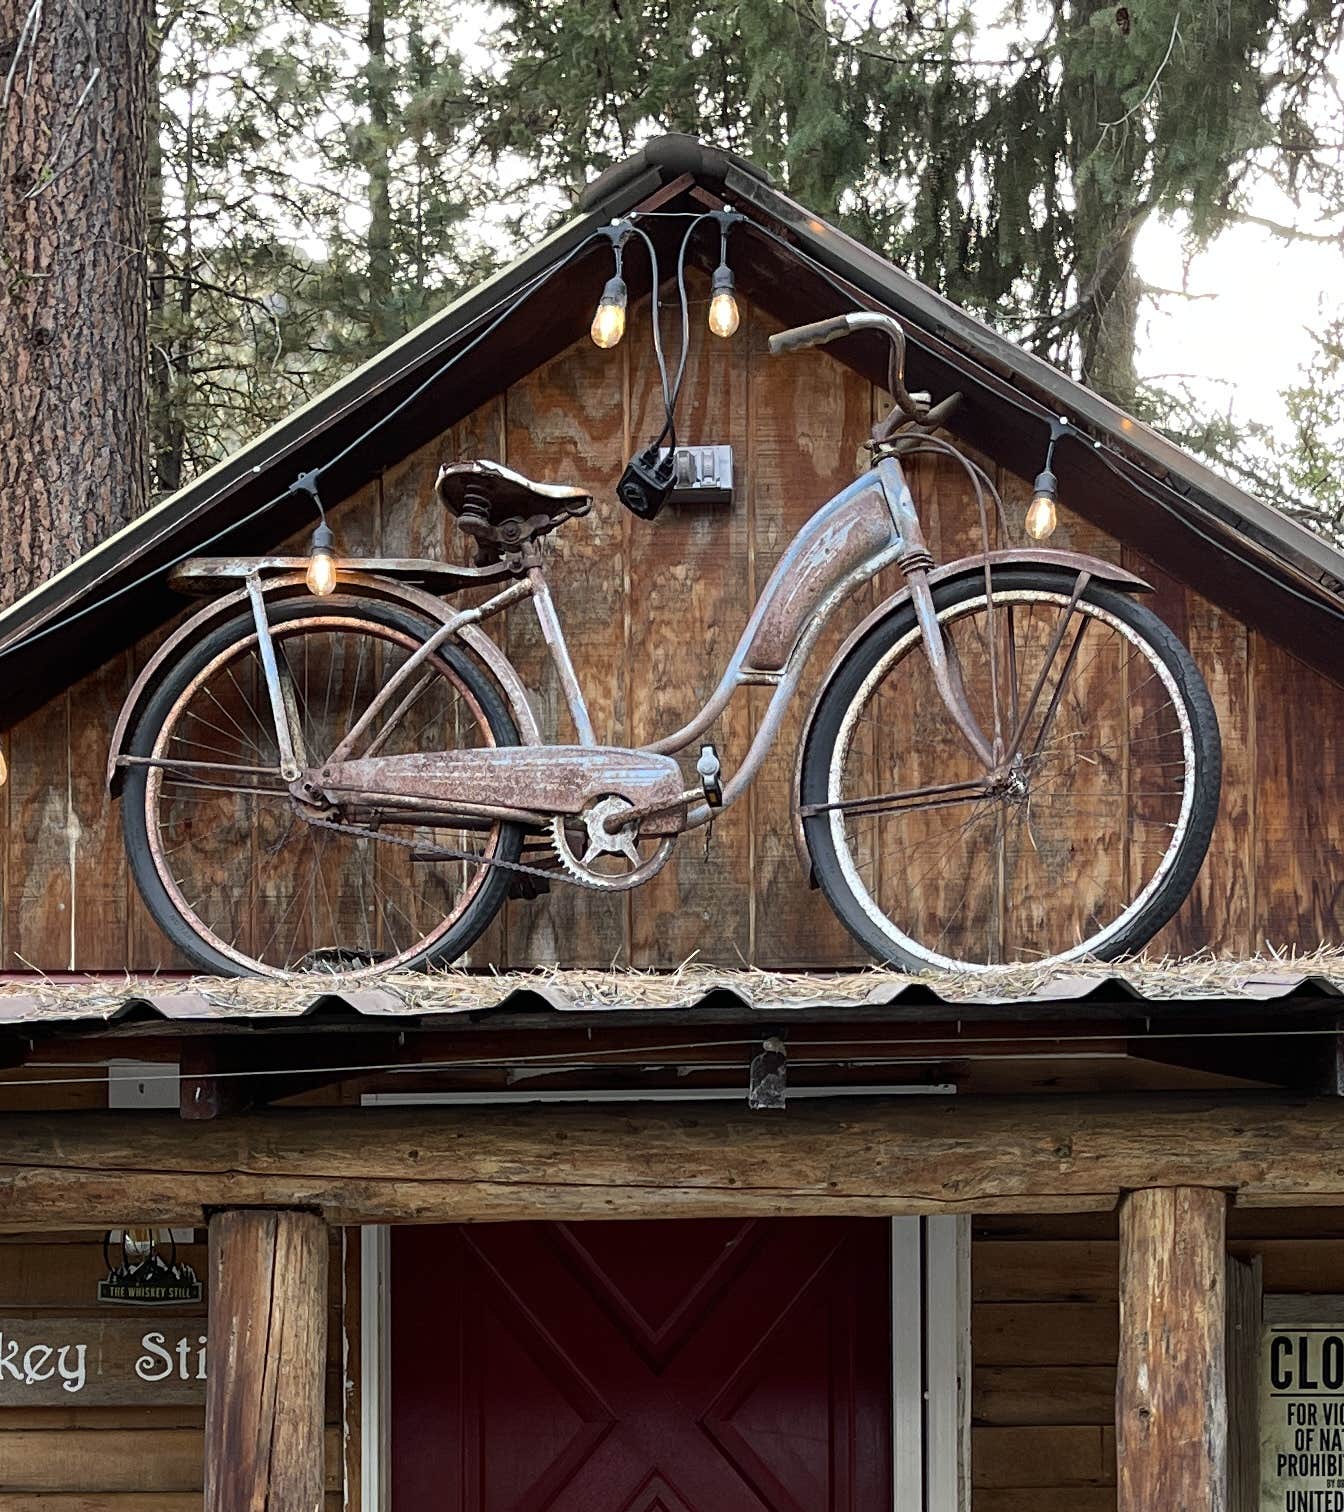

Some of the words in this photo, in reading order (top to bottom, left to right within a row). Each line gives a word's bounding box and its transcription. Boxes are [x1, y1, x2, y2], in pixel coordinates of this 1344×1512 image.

[109, 1286, 125, 1298] THE
[127, 1287, 166, 1298] WHISKEY
[168, 1287, 191, 1299] STILL
[135, 1332, 208, 1382] Sti
[1287, 1402, 1317, 1427] FOR
[1295, 1428, 1315, 1452] OF
[1326, 1478, 1335, 1489] BY
